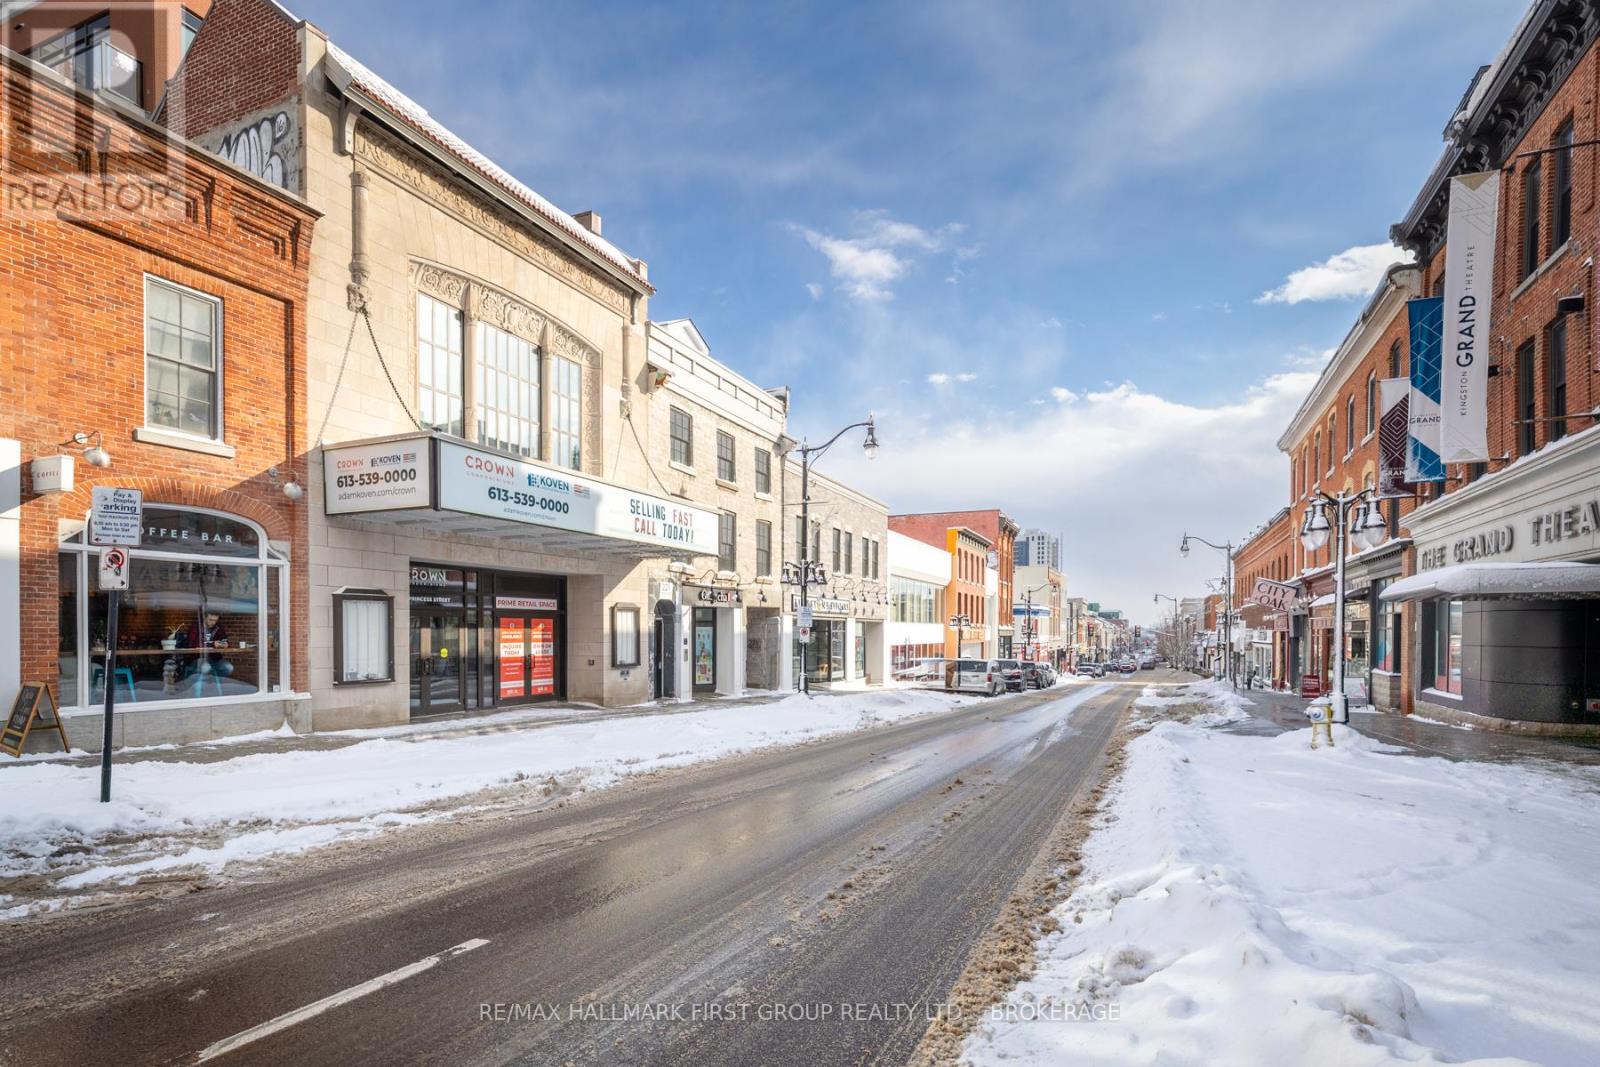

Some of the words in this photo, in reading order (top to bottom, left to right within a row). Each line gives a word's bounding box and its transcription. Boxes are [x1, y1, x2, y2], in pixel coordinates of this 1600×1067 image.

[1464, 245, 1475, 291] THEATRE
[1456, 295, 1476, 368] GRAND
[1459, 370, 1468, 416] KINGSTON
[337, 459, 364, 469] CROWN
[379, 454, 401, 465] KOVEN
[465, 455, 515, 478] CROWN
[336, 468, 417, 488] 613-539-0000
[540, 475, 570, 492] KOVEN
[338, 487, 416, 500] adamkoven.com/crown
[488, 486, 570, 514] 613-539-0000
[630, 498, 666, 521] SELLING
[673, 508, 693, 527] FAST
[201, 531, 233, 544] BAR
[634, 517, 657, 536] CALL
[662, 523, 694, 544] TODAY!
[1421, 544, 1447, 571] THE
[1454, 525, 1514, 562] GRAND
[1257, 582, 1290, 599] CITY
[517, 600, 537, 608] RETAIL
